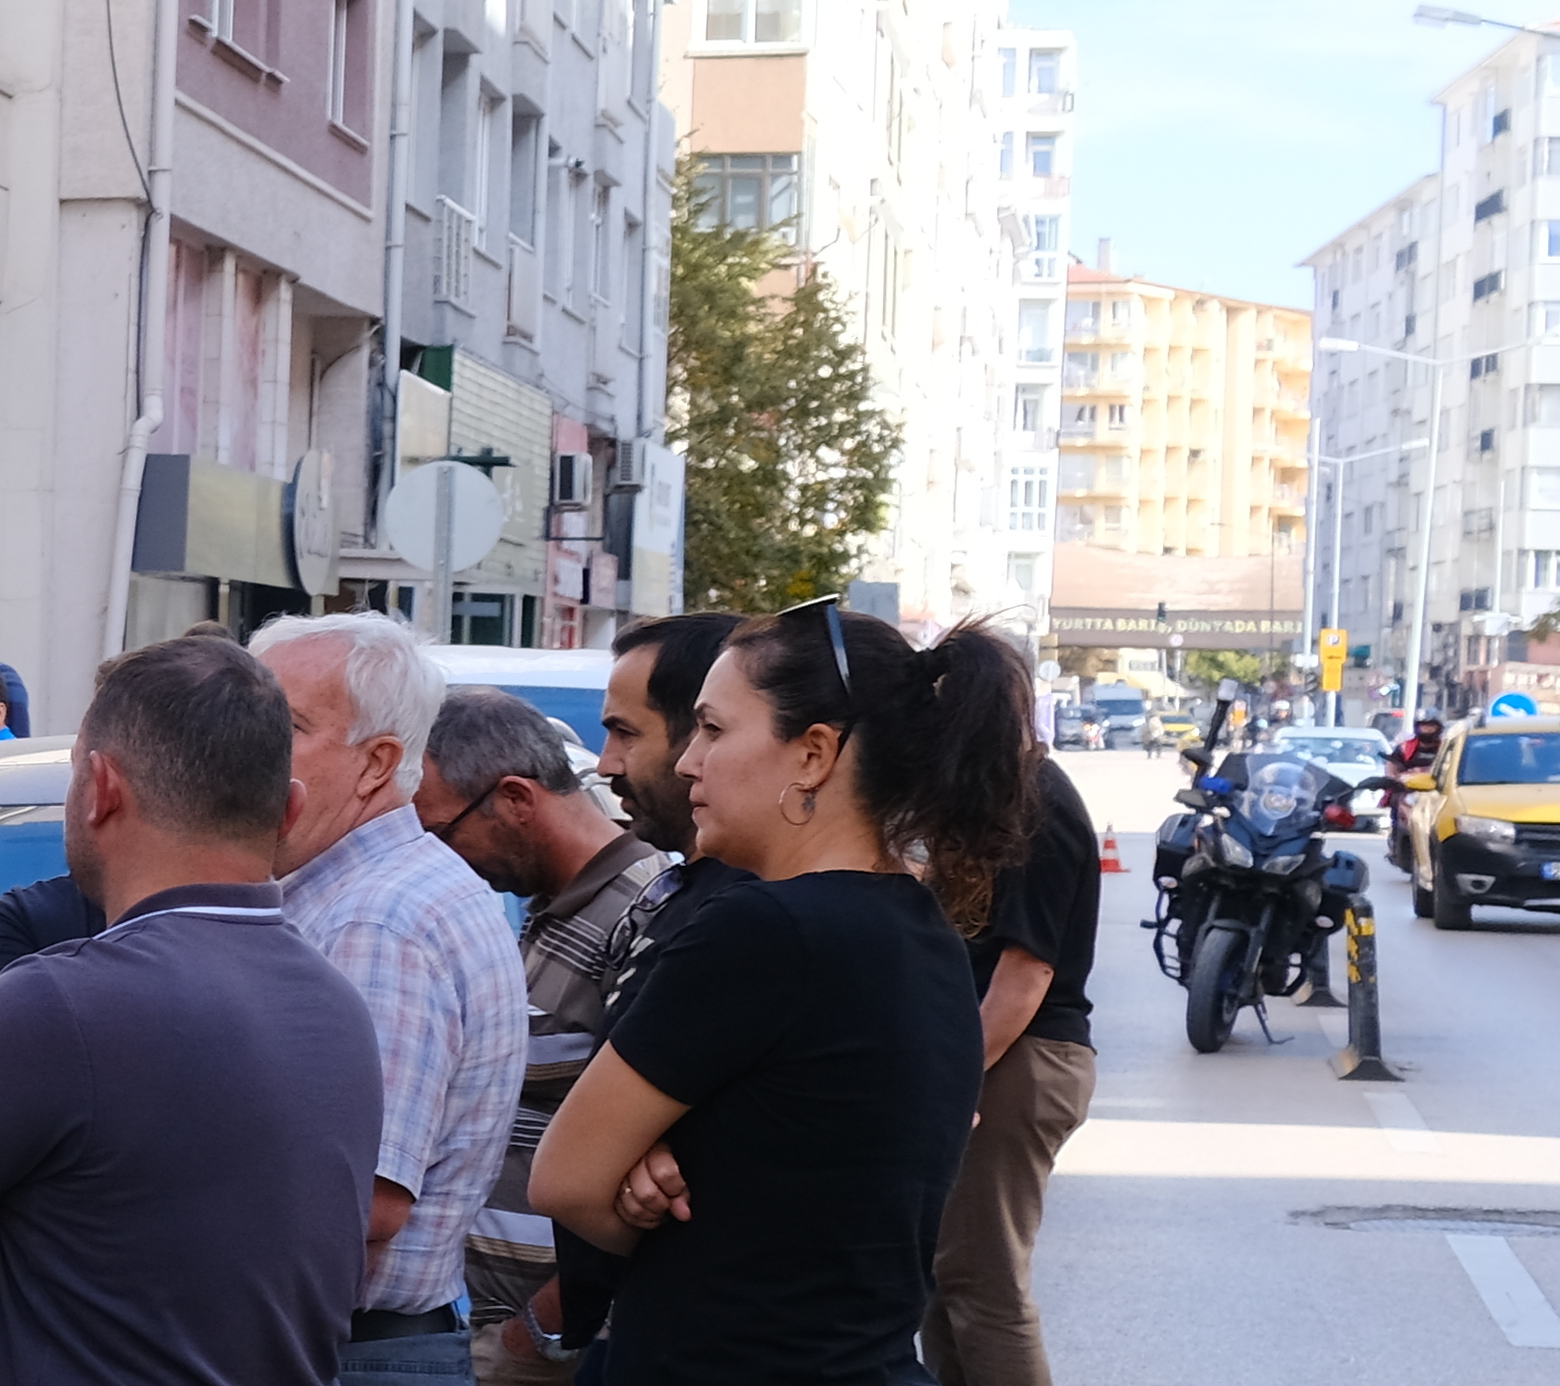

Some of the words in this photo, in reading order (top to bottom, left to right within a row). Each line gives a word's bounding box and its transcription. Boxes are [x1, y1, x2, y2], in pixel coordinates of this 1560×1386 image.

[1052, 617, 1114, 630] YURTTA
[1176, 617, 1257, 633] DÜNYADA
[1261, 619, 1303, 633] BARI
